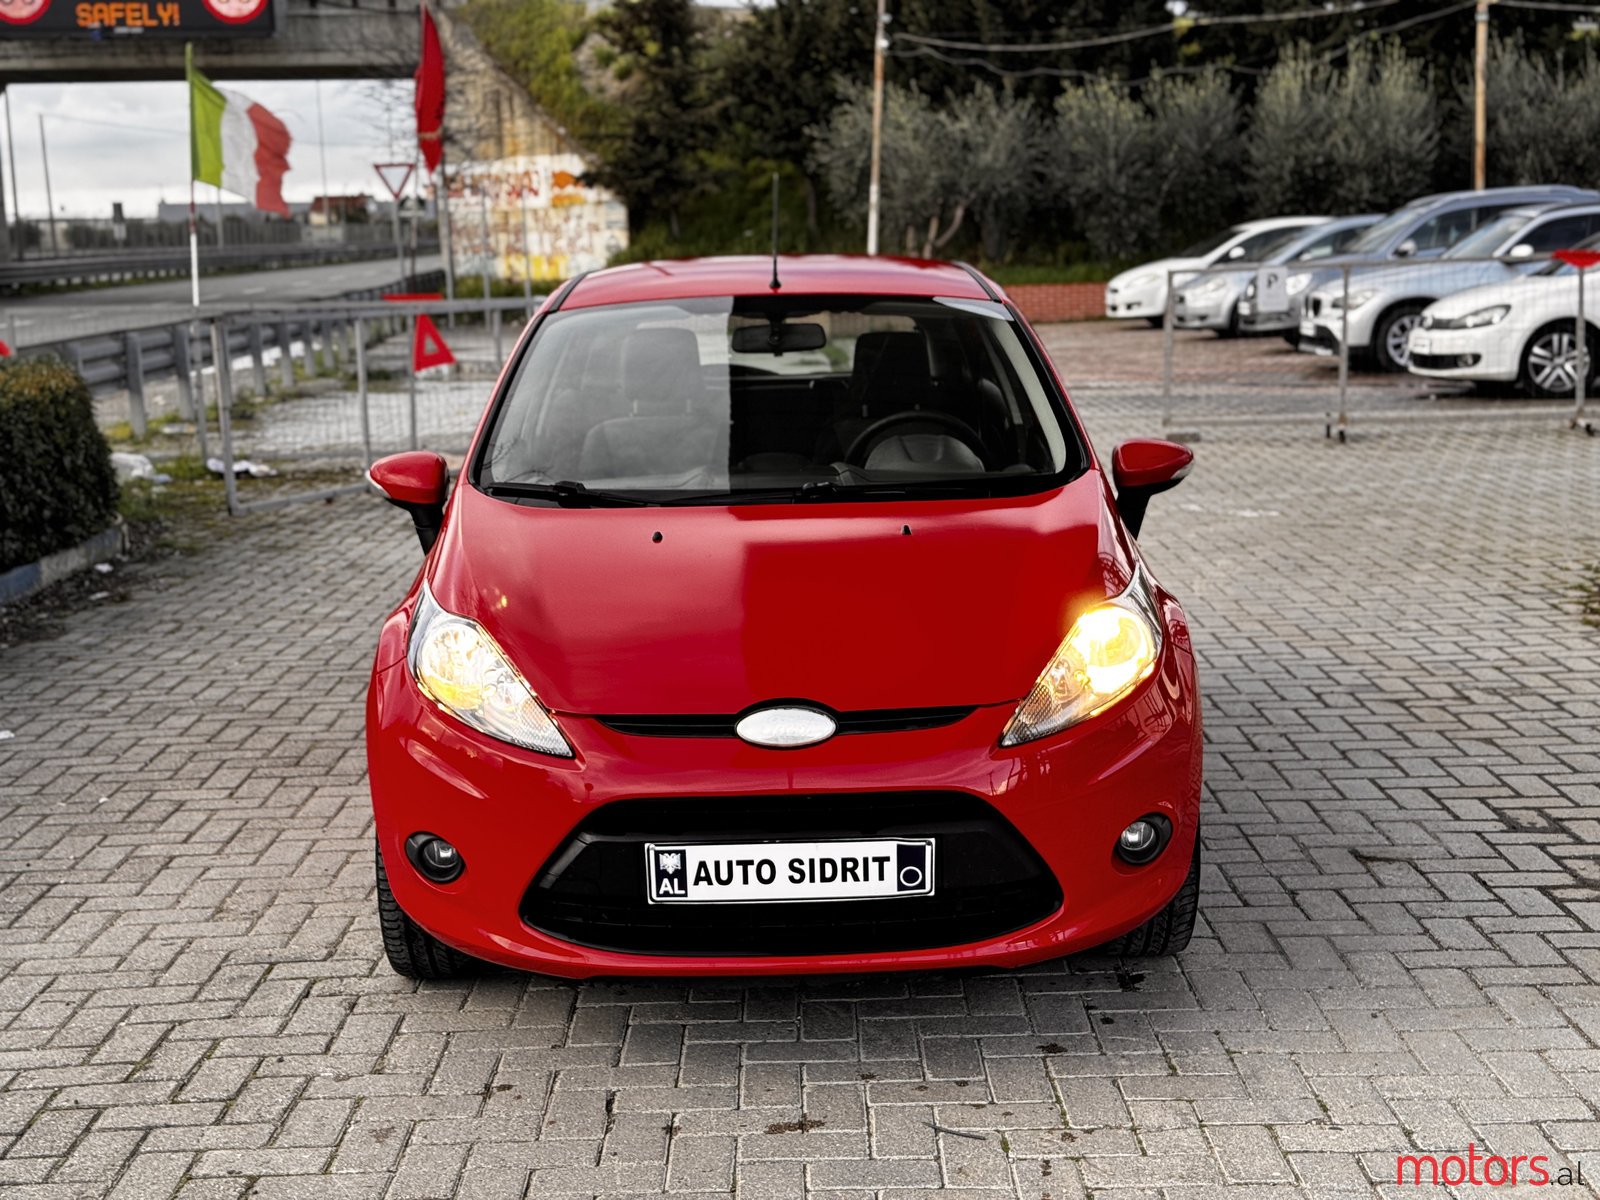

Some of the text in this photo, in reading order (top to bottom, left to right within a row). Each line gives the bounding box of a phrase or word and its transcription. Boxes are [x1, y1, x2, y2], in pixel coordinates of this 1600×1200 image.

[75, 3, 180, 27] SAFELY!
[693, 856, 891, 886] AUTO SIDRIT
[658, 878, 686, 895] AL
